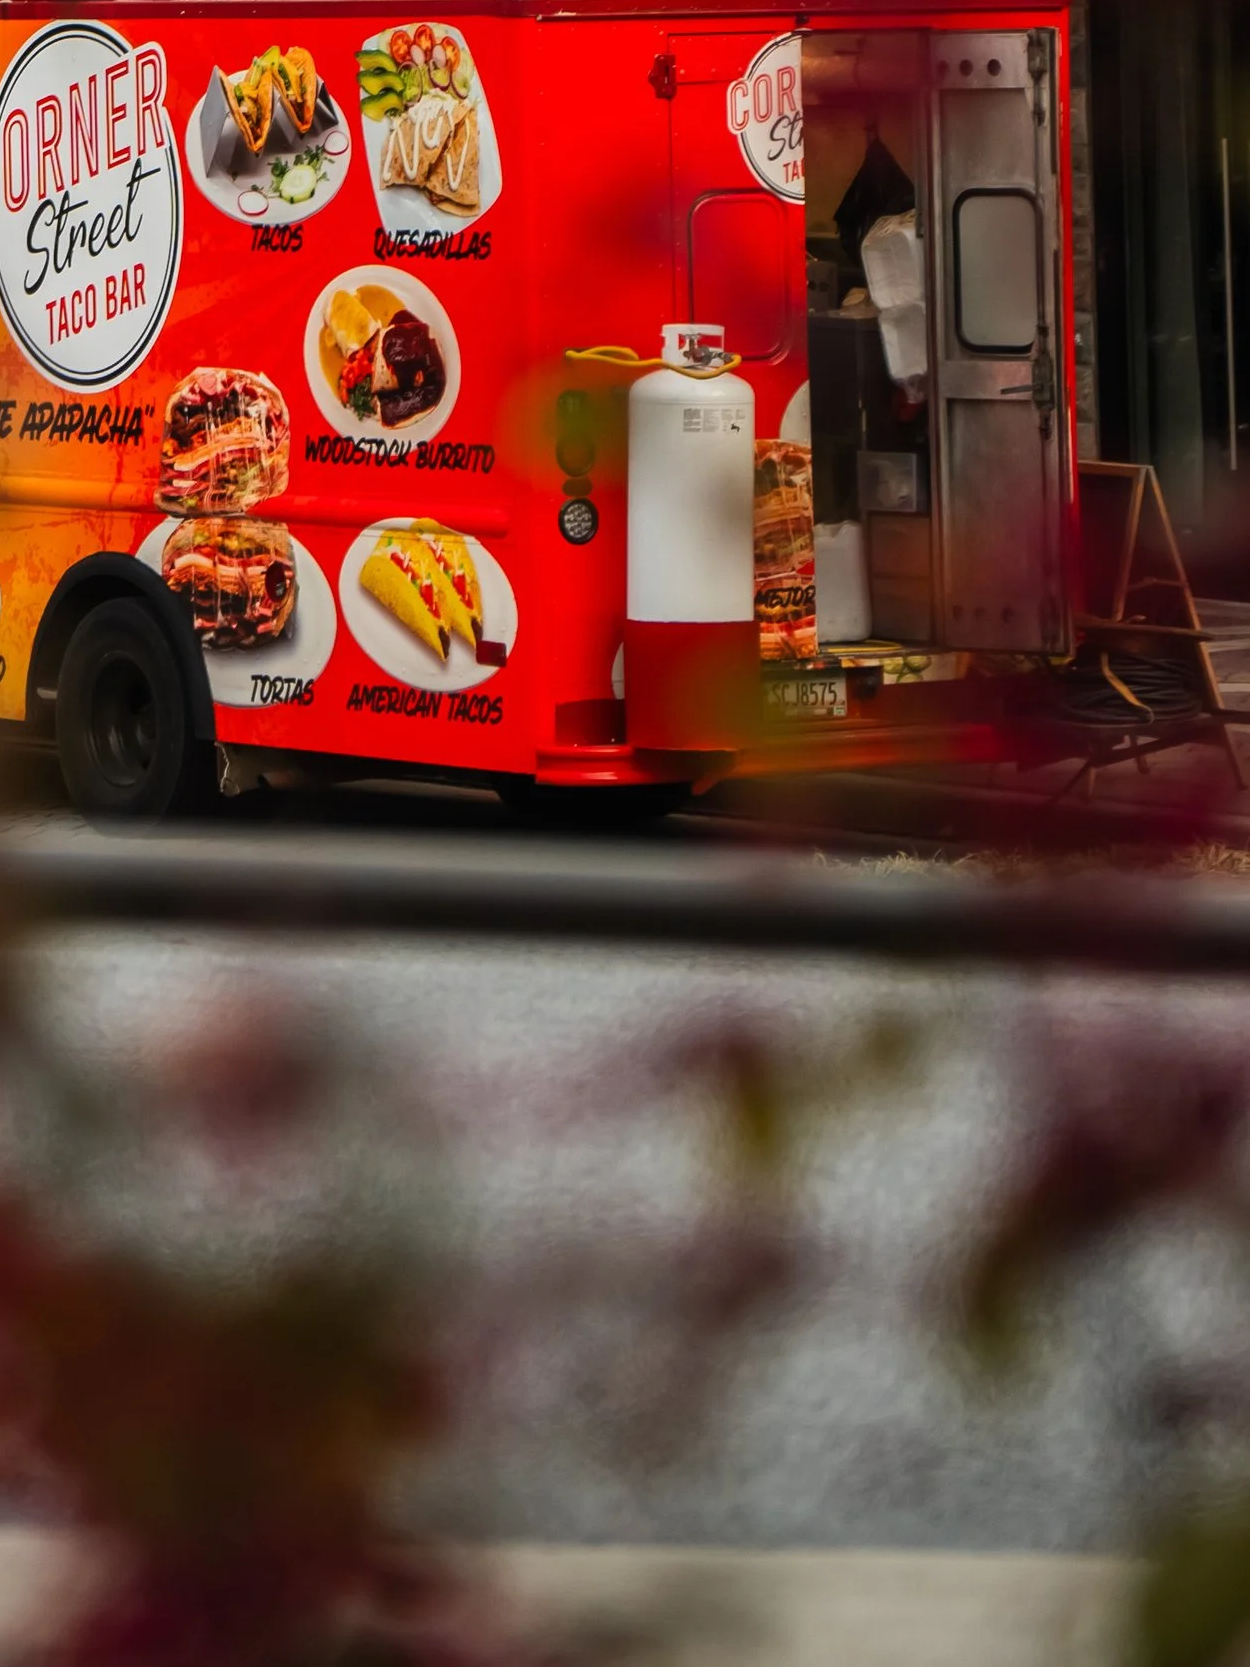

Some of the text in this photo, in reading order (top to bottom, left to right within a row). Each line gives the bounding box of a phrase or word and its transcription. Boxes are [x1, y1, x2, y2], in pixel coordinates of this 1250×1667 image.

[730, 65, 797, 131] COR
[23, 158, 162, 296] Street
[250, 224, 304, 253] TACOS
[373, 230, 493, 261] QUESADILLAS
[45, 262, 147, 346] TACO BAR
[19, 402, 155, 446] APAPACHA"
[305, 434, 496, 474] WOODSTOCK BURRITO
[250, 674, 315, 706] TORTAS
[346, 684, 503, 725] AMERICAN TACOS
[771, 682, 838, 706] SCJ8575
